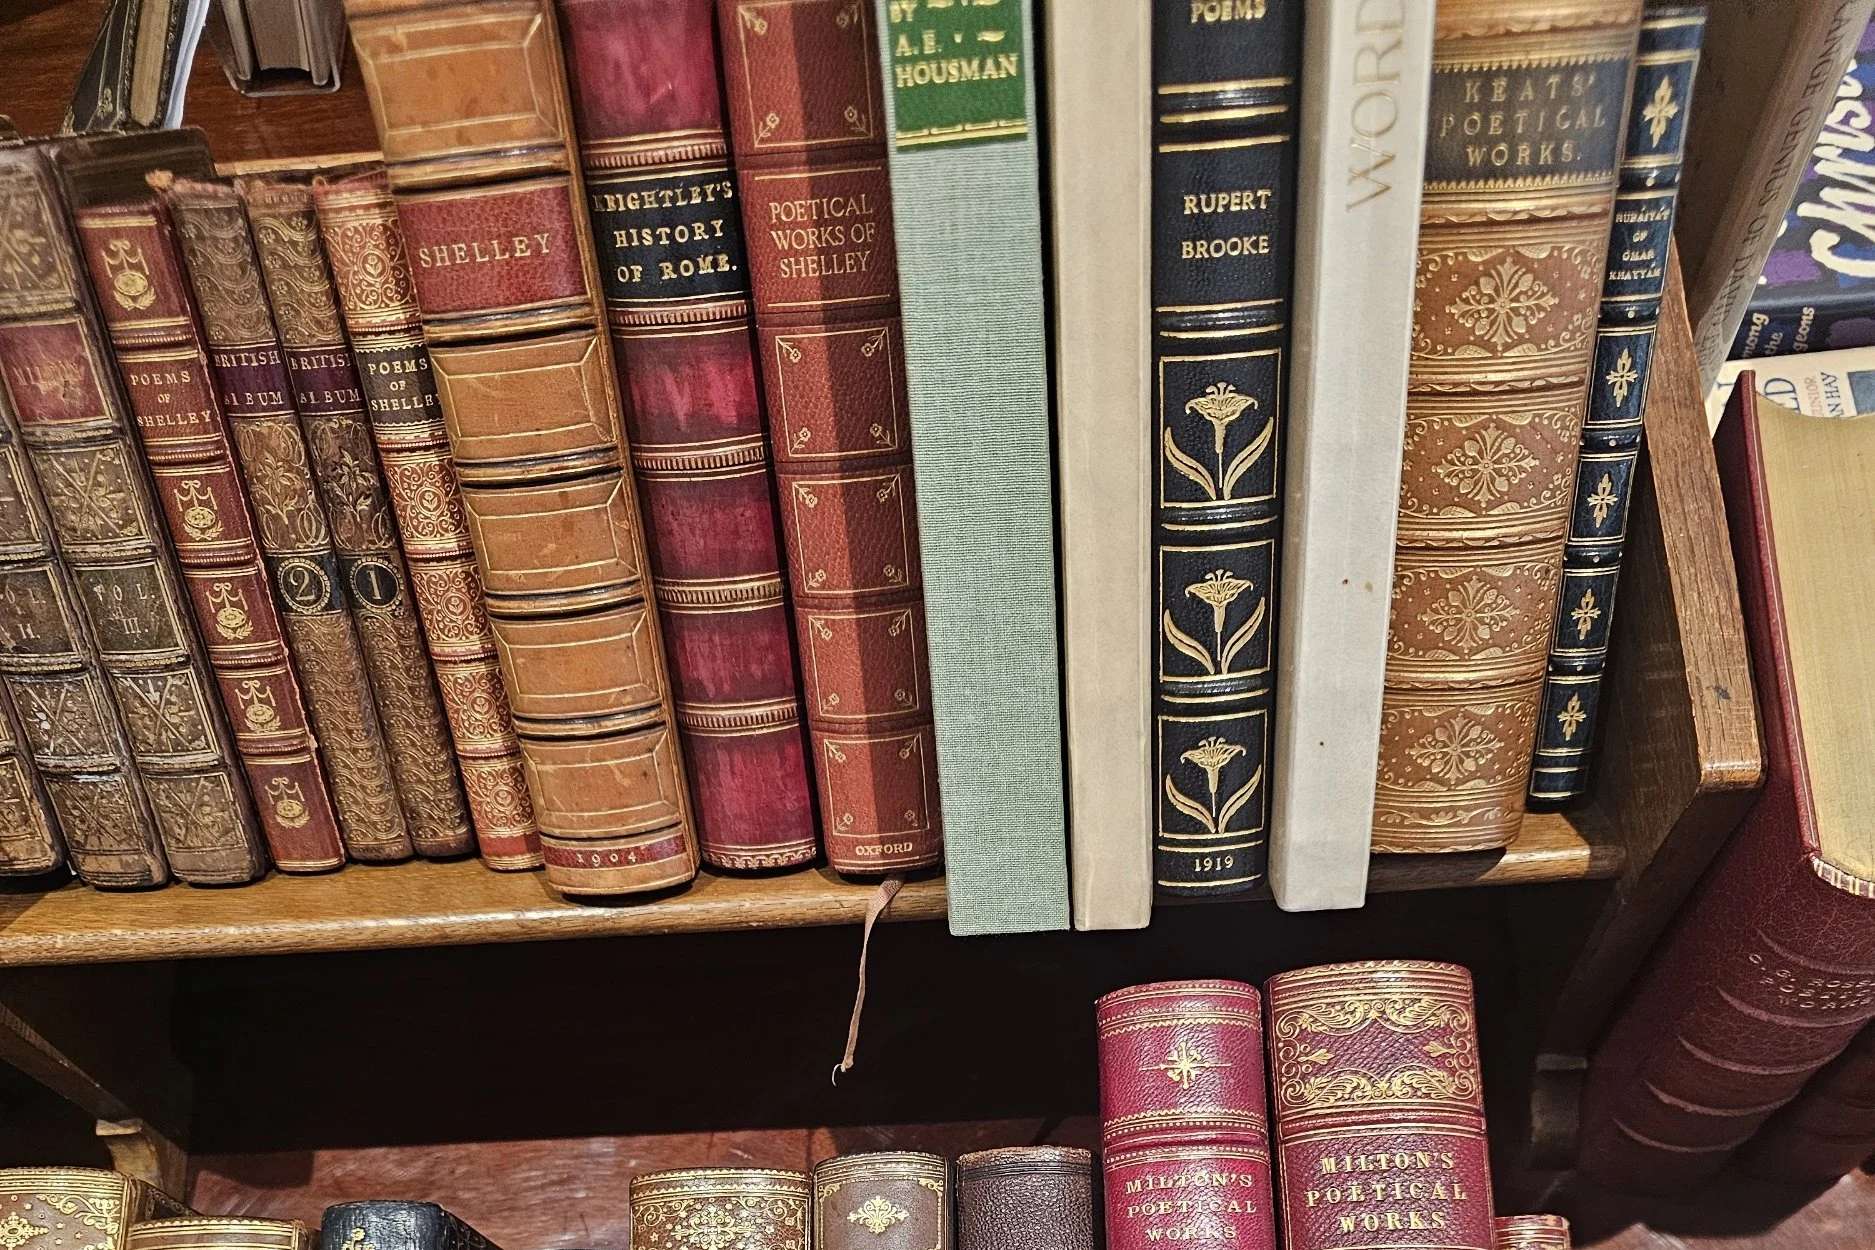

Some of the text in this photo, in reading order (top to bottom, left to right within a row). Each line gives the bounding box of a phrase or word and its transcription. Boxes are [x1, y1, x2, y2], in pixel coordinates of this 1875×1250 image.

[890, 1, 917, 23] BY
[1190, 0, 1267, 24] POEMS
[895, 53, 1018, 87] HOUSMAN
[1440, 104, 1606, 138] POETICAL
[1758, 107, 1812, 206] GENIUS
[769, 194, 873, 223] POETICAL
[1184, 189, 1272, 214] RUPERT
[614, 219, 724, 247] HISTORY
[770, 222, 876, 250] WORKS OF
[1632, 230, 1649, 242] OF
[419, 233, 551, 268] SHELLEY
[1181, 235, 1270, 259] BROOKE
[617, 253, 738, 283] OF ROME.
[780, 251, 871, 278] SHELLEY
[215, 350, 281, 367] BRITISH
[368, 358, 428, 375] POEMS
[131, 370, 191, 386] POEMS
[390, 380, 406, 391] OF
[1820, 371, 1842, 403] HAY
[158, 394, 172, 403] OF
[224, 391, 285, 406] ALBUM
[300, 388, 362, 404] ALBUM
[137, 411, 211, 427] SHELLEY
[0, 585, 46, 604] OL.
[290, 568, 315, 600] 2
[366, 570, 382, 600] 1
[576, 852, 636, 867] 1904
[855, 842, 913, 855] OXFORD
[1194, 855, 1234, 872] 1919
[1321, 1151, 1454, 1175] MILTON'S
[1126, 1173, 1253, 1195] MILTON'S
[1306, 1182, 1468, 1208] POETICAL
[1127, 1200, 1257, 1218] POETICAL
[1145, 1226, 1236, 1242] WORKS
[1339, 1211, 1446, 1234] WORKS
